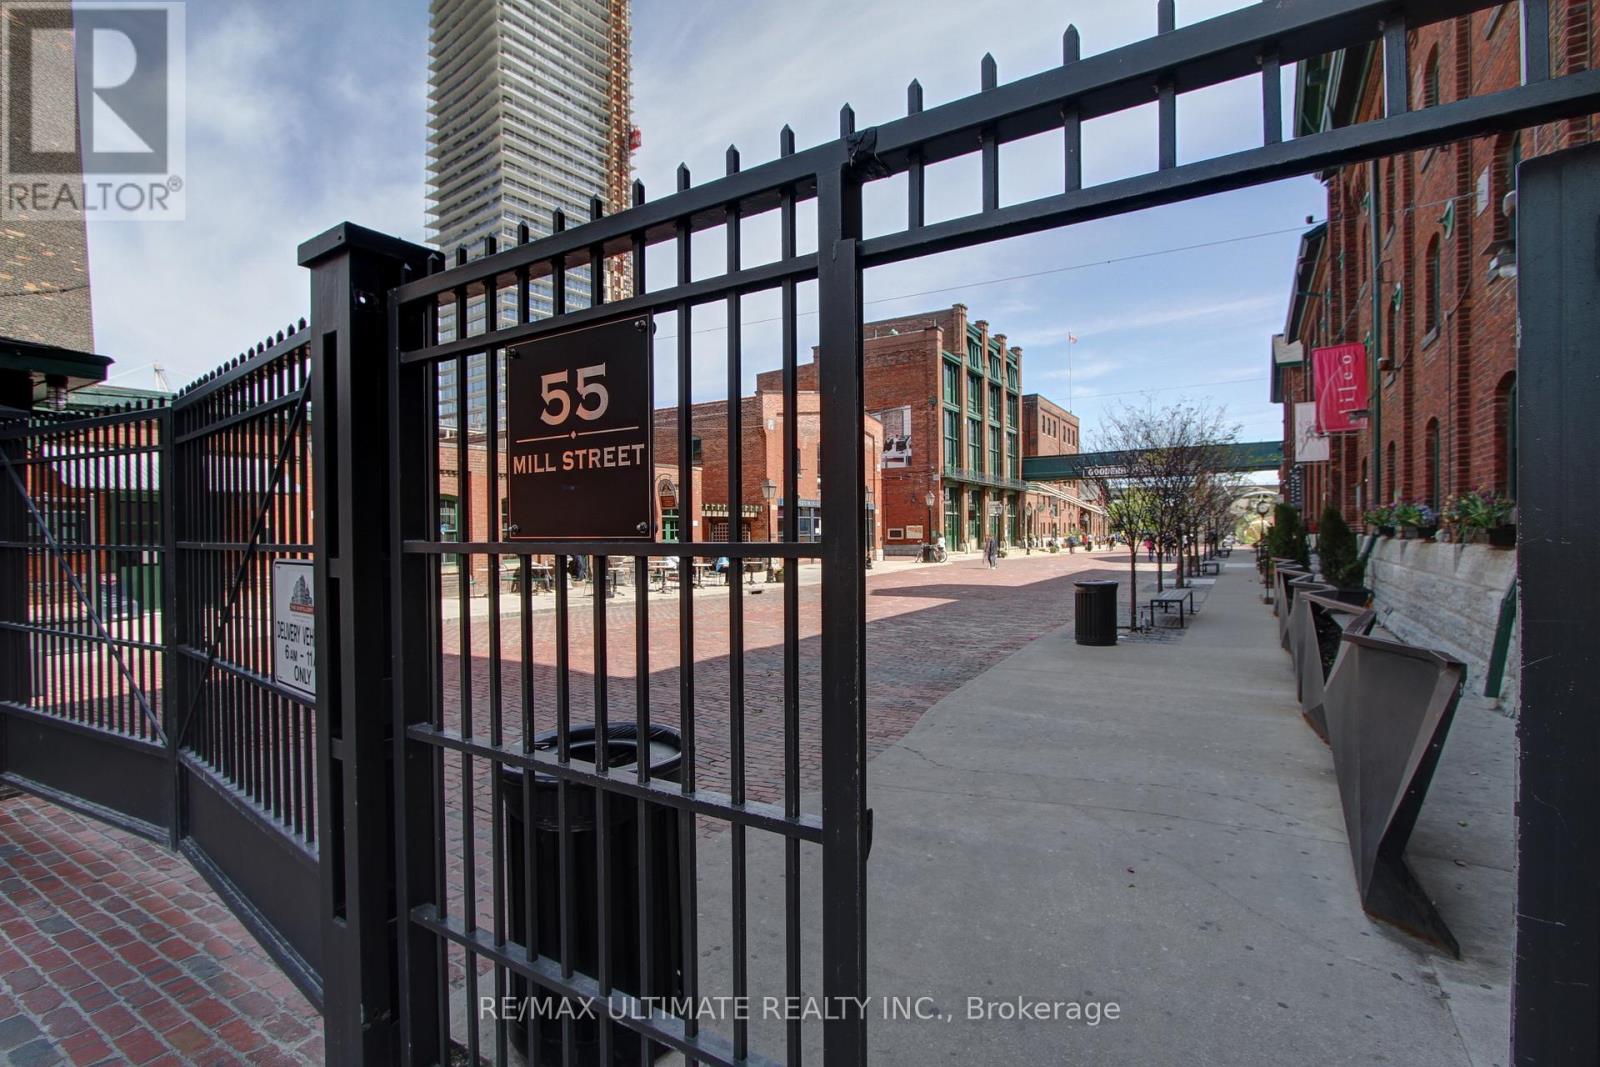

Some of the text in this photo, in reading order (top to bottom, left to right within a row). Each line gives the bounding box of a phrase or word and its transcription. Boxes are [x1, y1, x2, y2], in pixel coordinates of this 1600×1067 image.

[539, 362, 609, 426] 55
[513, 443, 645, 475] MILL STREET
[277, 620, 301, 643] DELIVERY
[294, 666, 312, 686] ONLY
